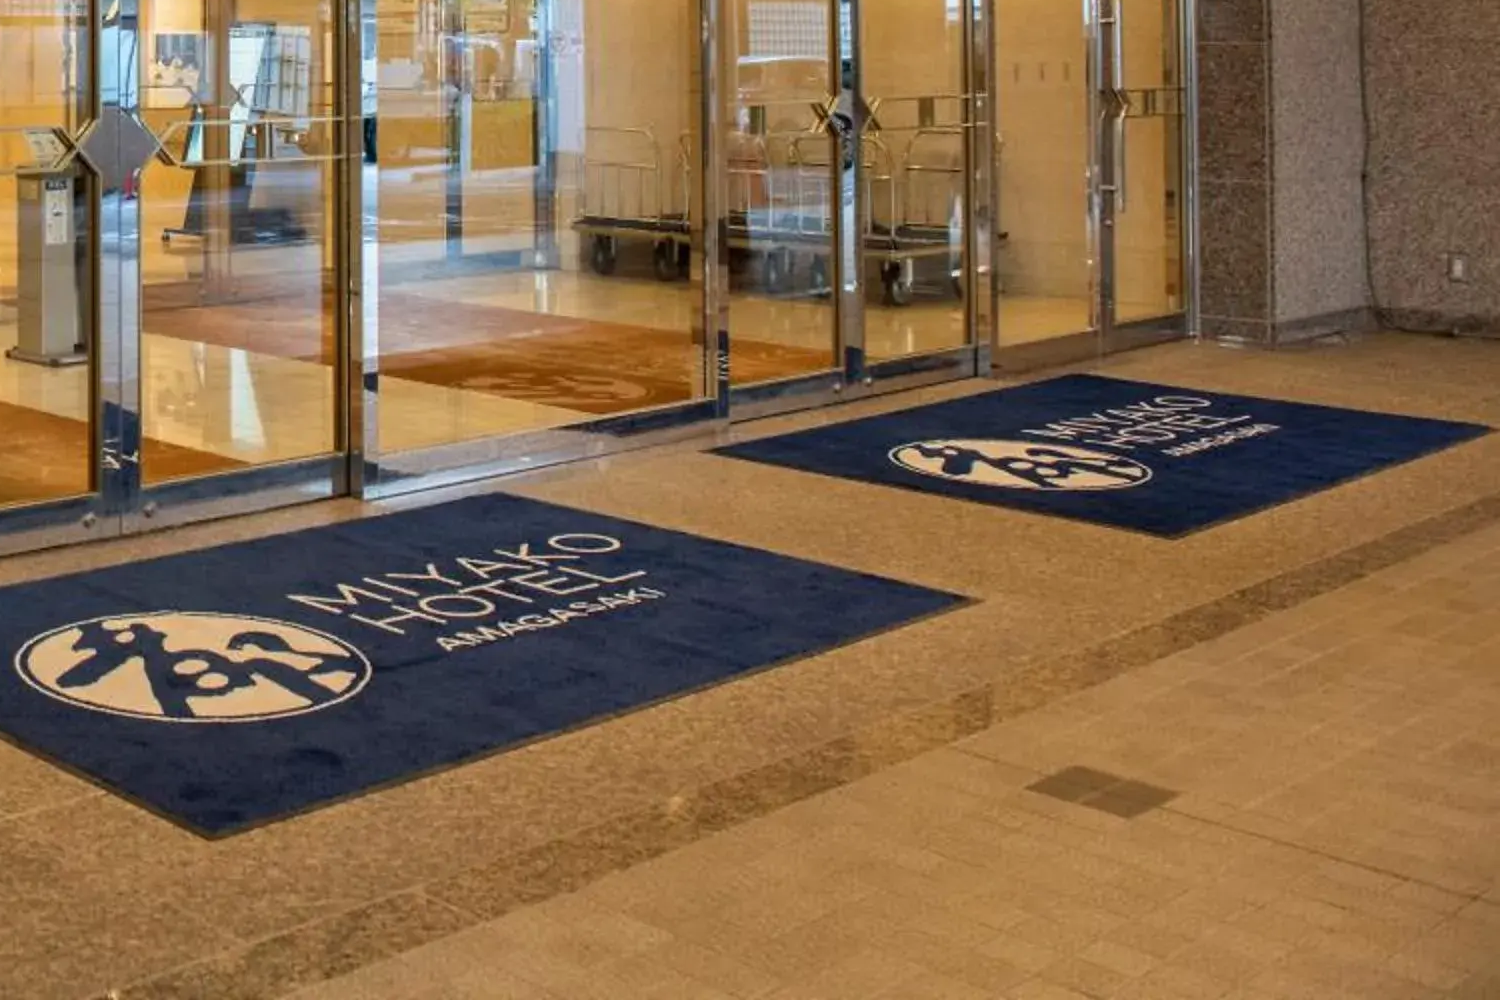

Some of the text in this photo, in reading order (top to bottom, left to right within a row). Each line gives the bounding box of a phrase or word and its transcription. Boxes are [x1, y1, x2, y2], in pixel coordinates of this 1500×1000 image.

[1020, 396, 1211, 440] MIYAKO
[1083, 413, 1251, 449] HOTEL
[286, 533, 621, 615] MIYAKO
[348, 565, 647, 634] HOTEL
[435, 586, 667, 652] AMAGASAKI
